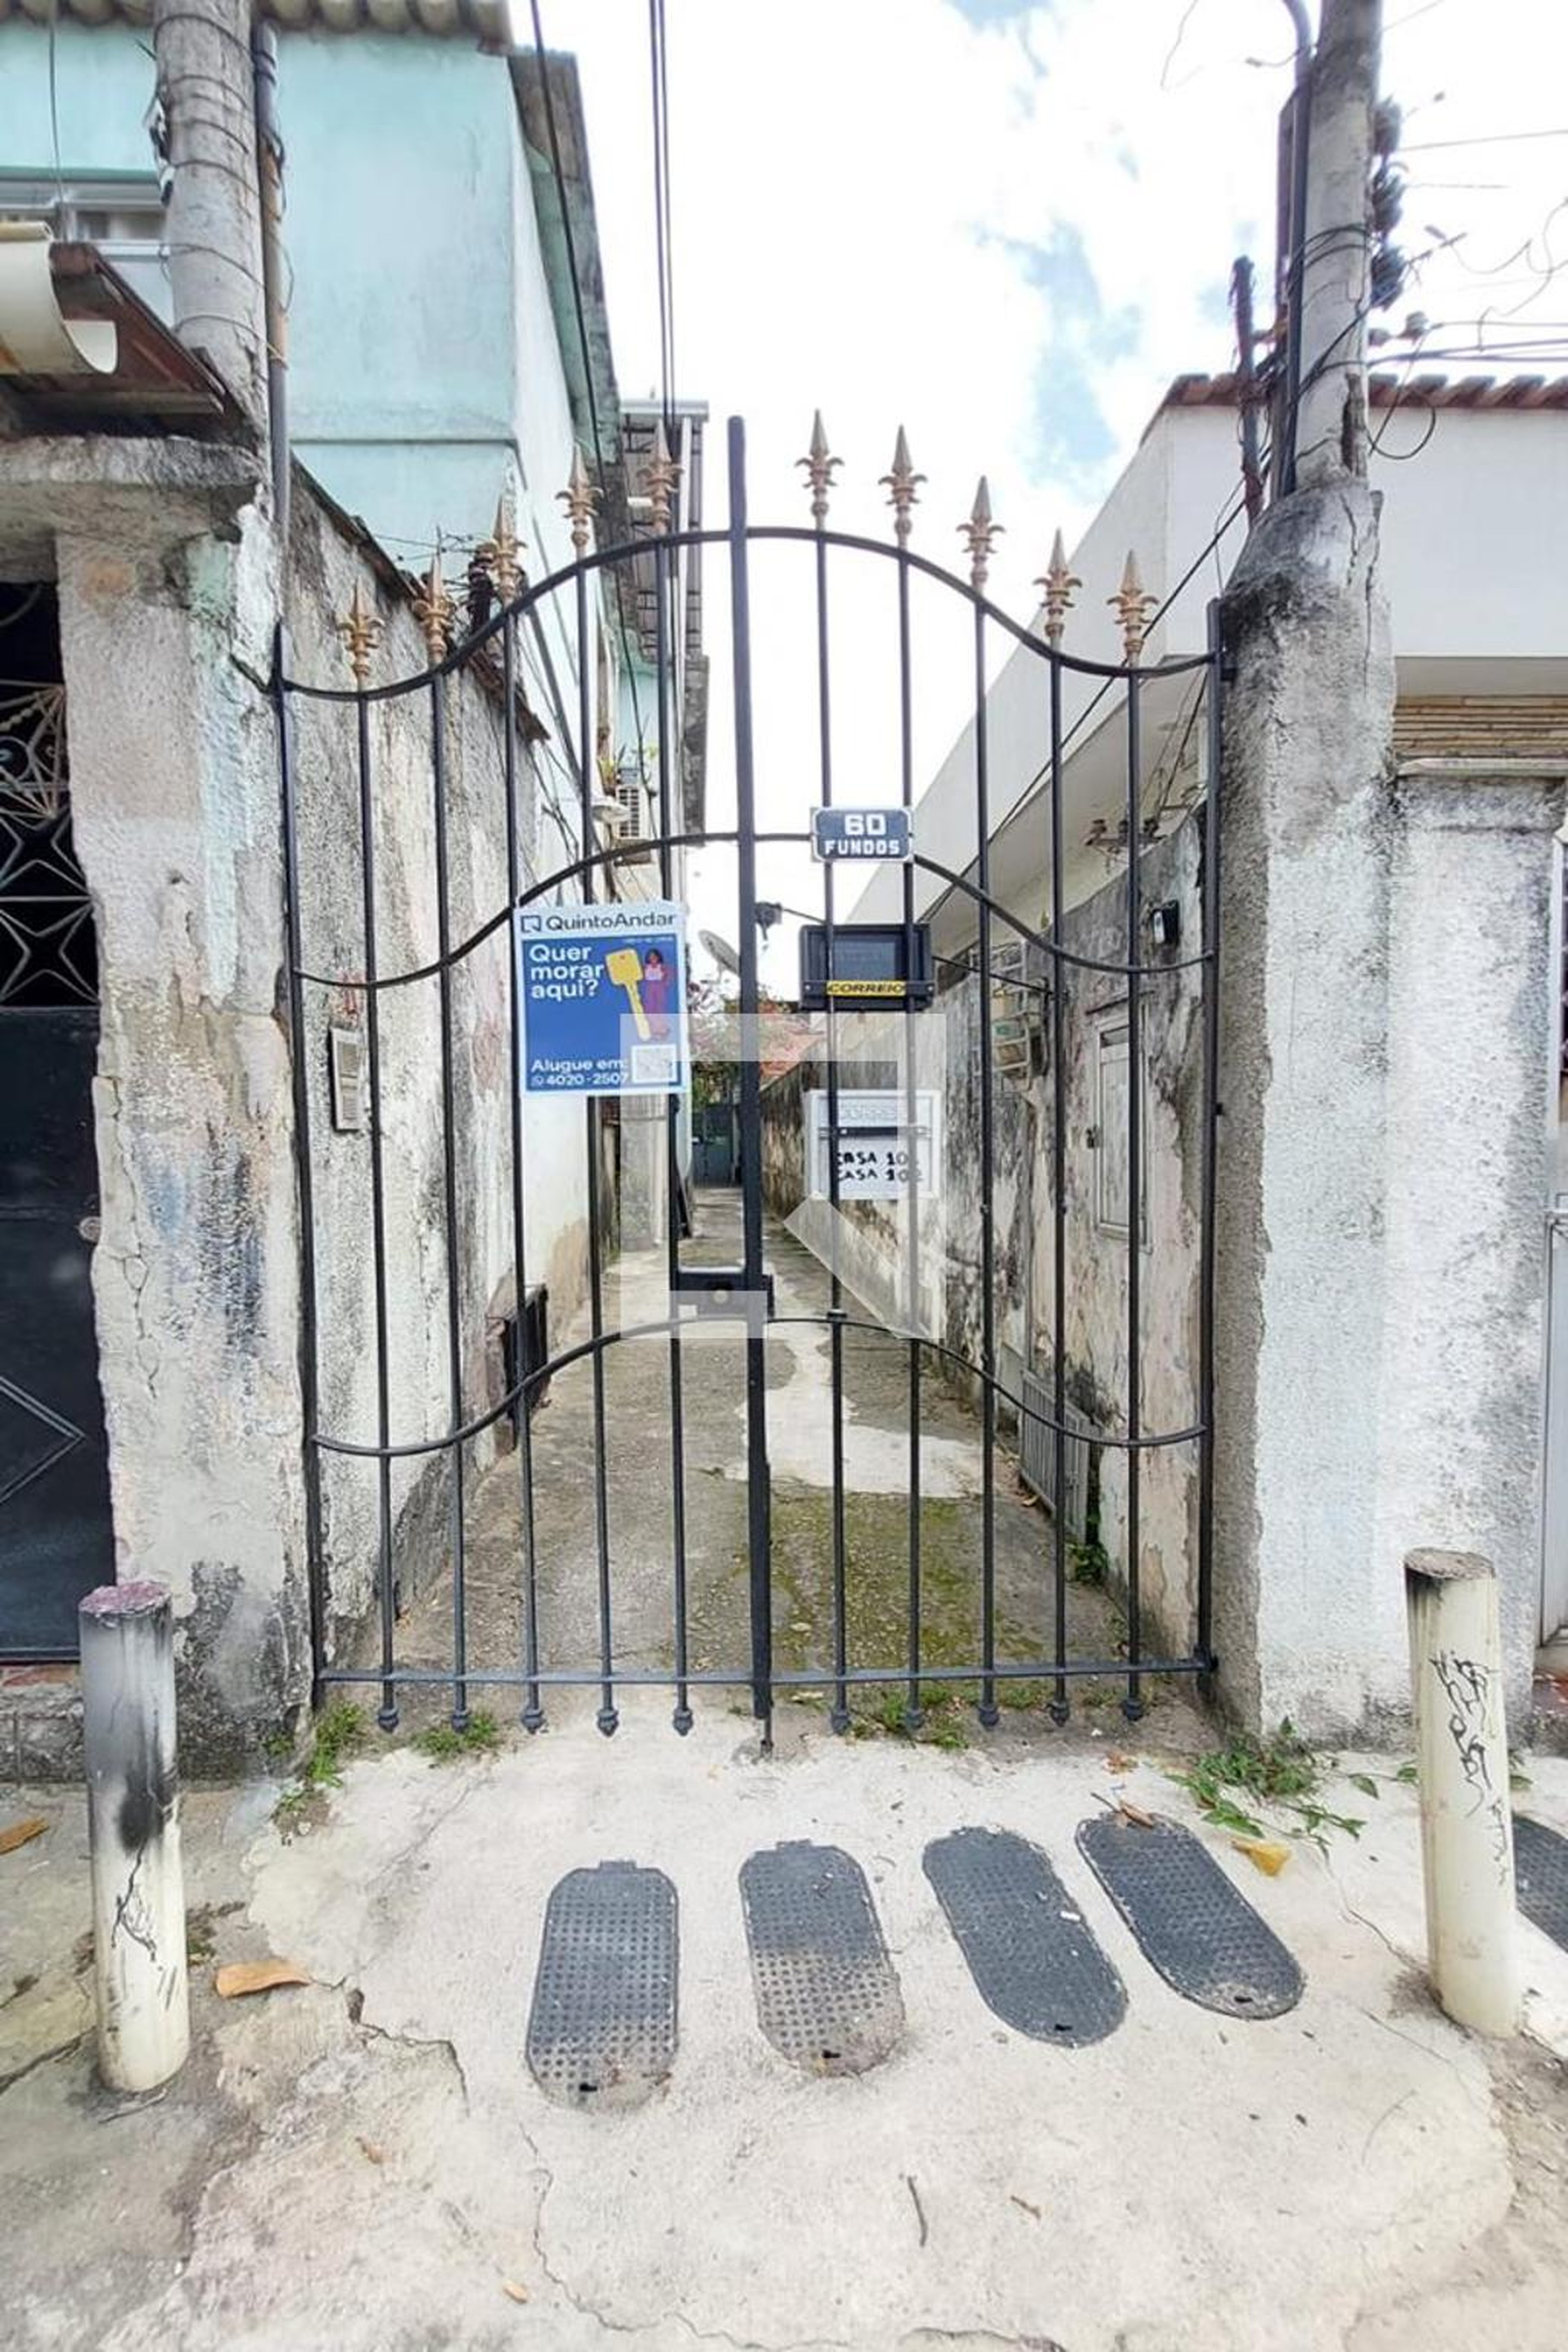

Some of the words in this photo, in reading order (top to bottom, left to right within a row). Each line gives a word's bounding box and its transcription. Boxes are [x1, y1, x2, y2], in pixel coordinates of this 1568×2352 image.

[844, 814, 886, 835] 60
[824, 839, 900, 855] FUNDOS
[546, 912, 674, 932] QuintoAndar
[530, 944, 591, 962] Quer
[531, 964, 604, 980] morar
[532, 980, 599, 1002] aqui?
[827, 983, 903, 993] CORREIO
[531, 1059, 593, 1074] Alugue
